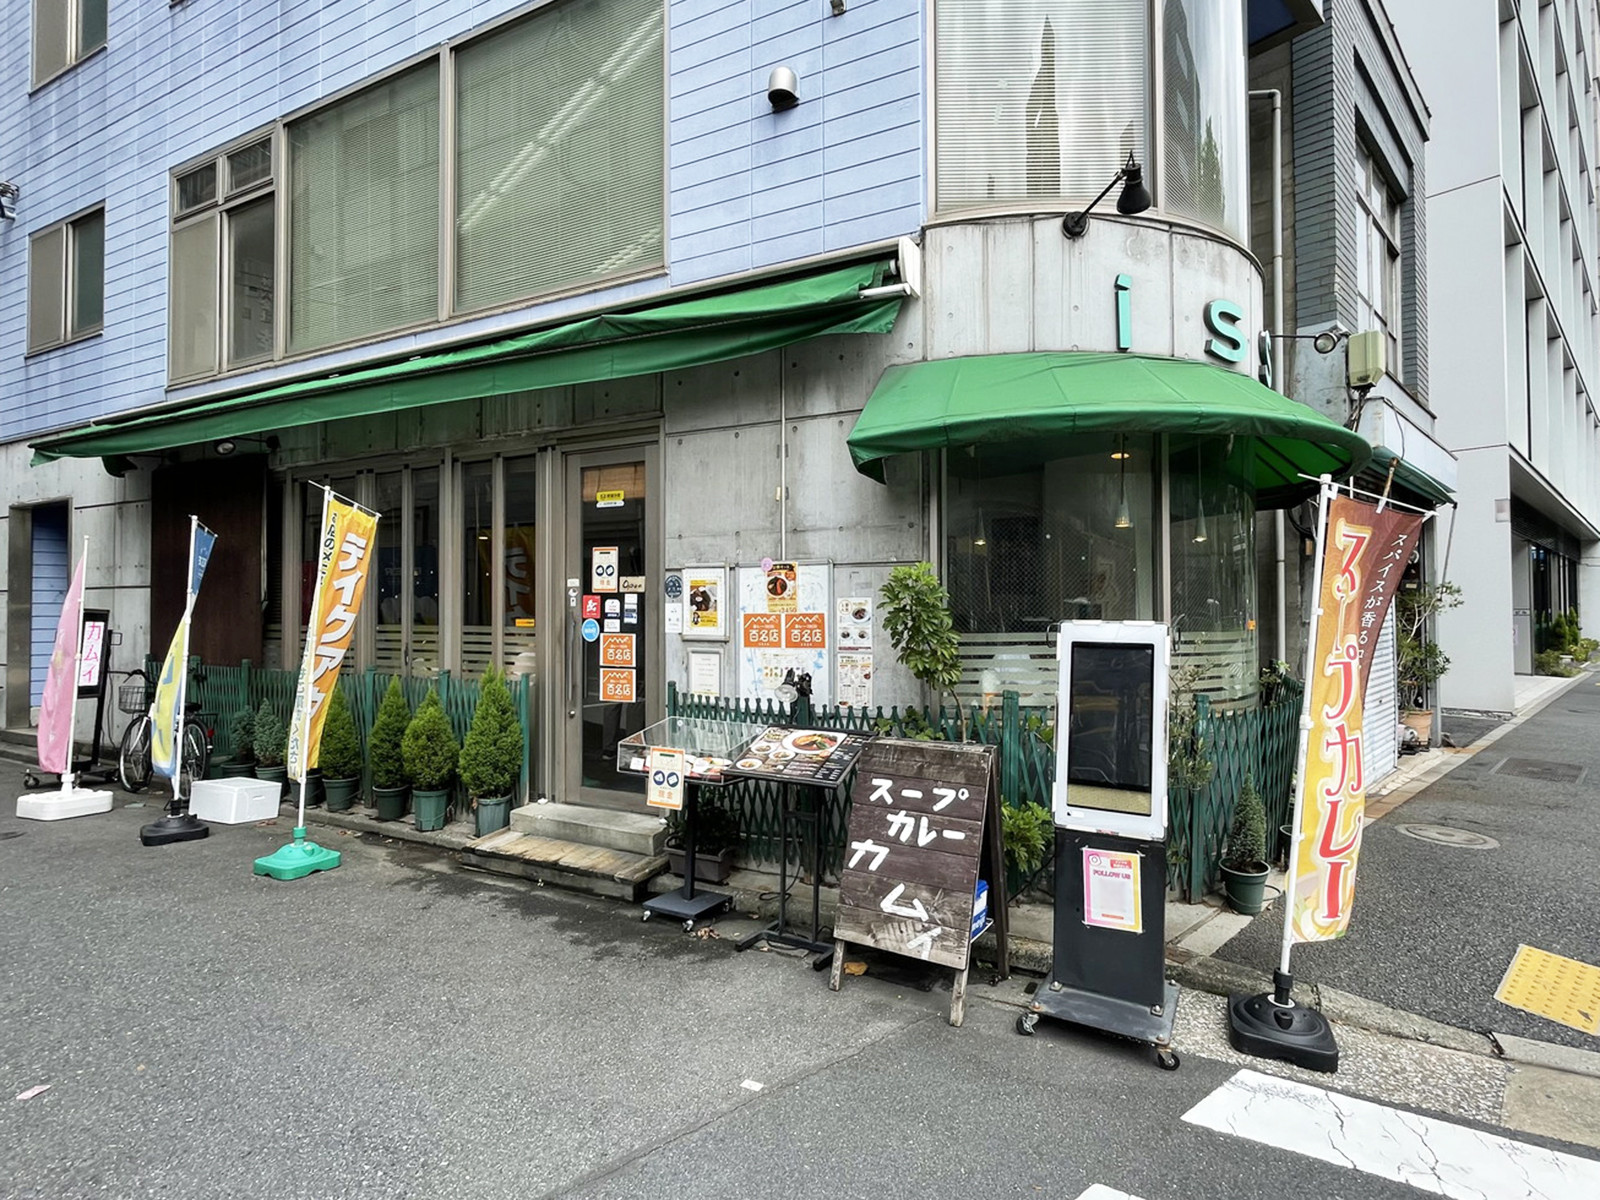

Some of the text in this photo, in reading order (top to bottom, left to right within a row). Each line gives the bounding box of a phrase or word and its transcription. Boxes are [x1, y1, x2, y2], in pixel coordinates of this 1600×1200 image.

[82, 621, 101, 684] カムイ
[749, 629, 779, 642] 百名店
[790, 629, 822, 642] 百名店
[1317, 530, 1368, 920] スープカレー
[869, 778, 969, 812] スープ
[886, 810, 966, 847] カレー
